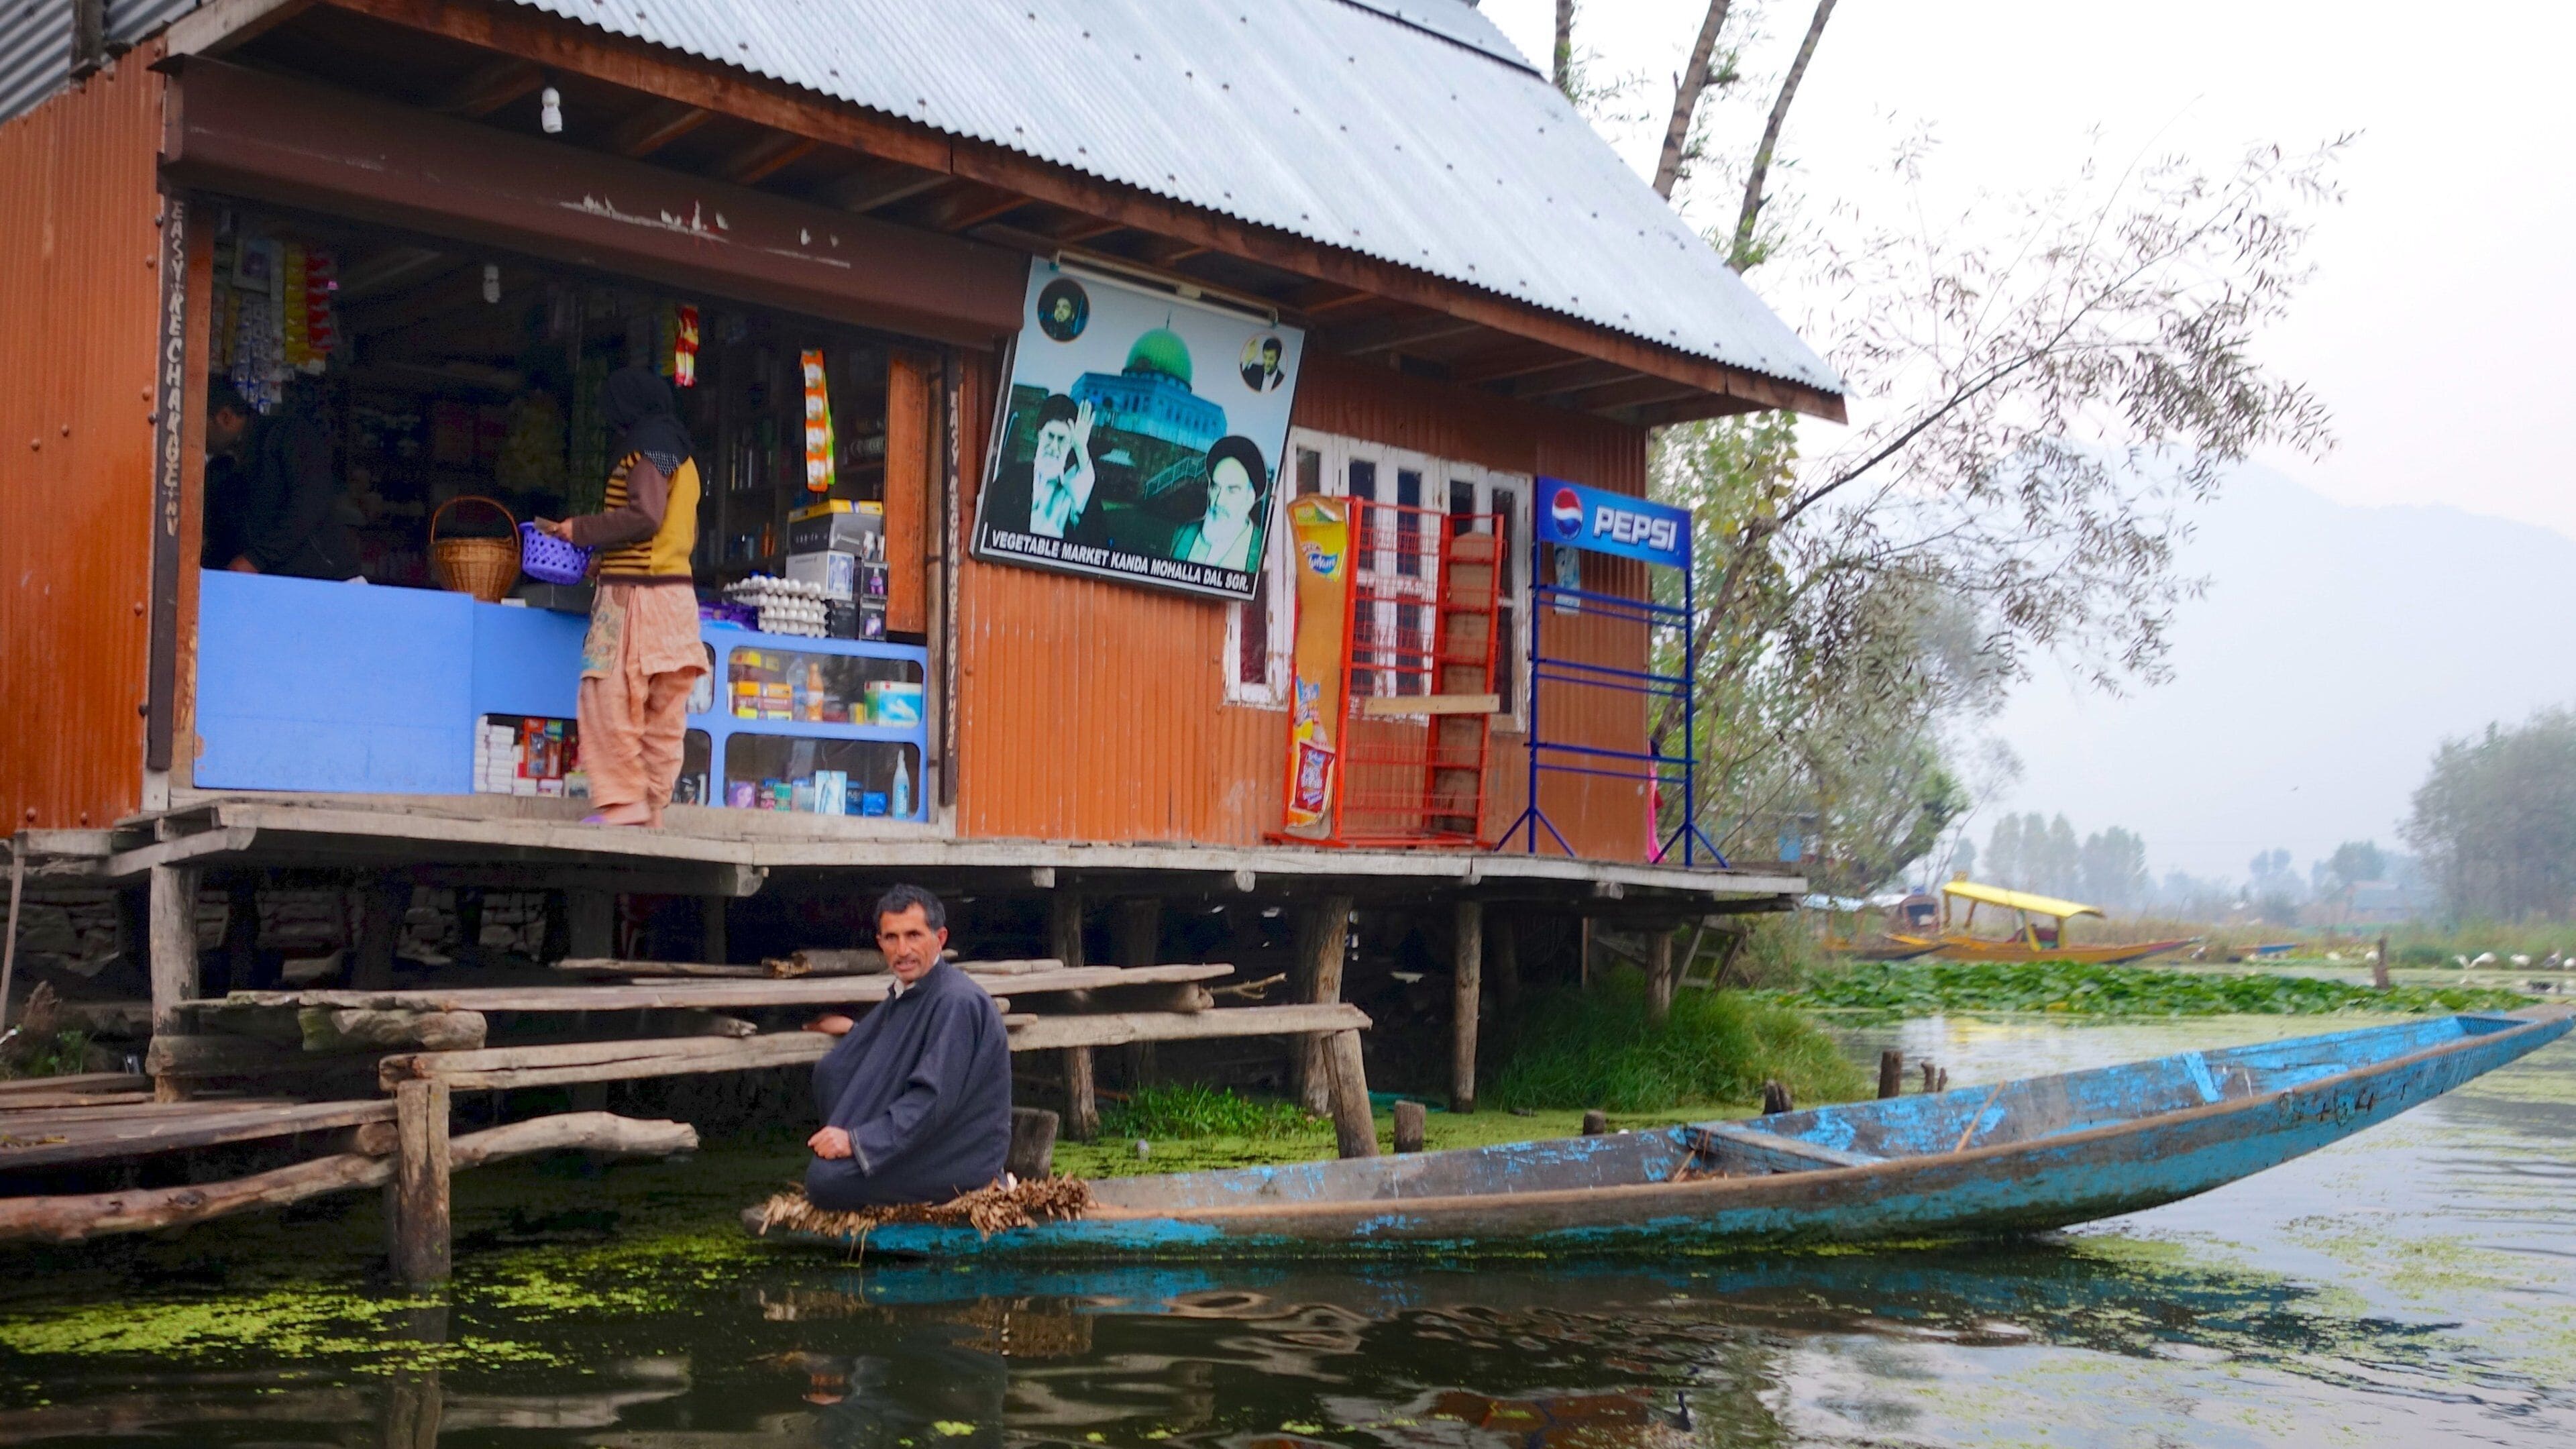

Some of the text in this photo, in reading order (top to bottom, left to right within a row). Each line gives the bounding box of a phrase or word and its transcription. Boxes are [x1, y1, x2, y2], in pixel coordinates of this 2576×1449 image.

[170, 201, 184, 281] EASY
[163, 291, 184, 488] RECHARGE
[949, 390, 959, 467] EASY
[947, 474, 959, 624] RECHARGE
[992, 529, 1061, 559] VEGETABLE
[1061, 542, 1110, 567] MARKET
[1110, 551, 1148, 574] KANDA
[1150, 558, 1202, 584] MOHALLA
[1202, 568, 1223, 588] DAL
[1593, 504, 1678, 552] PEPSI
